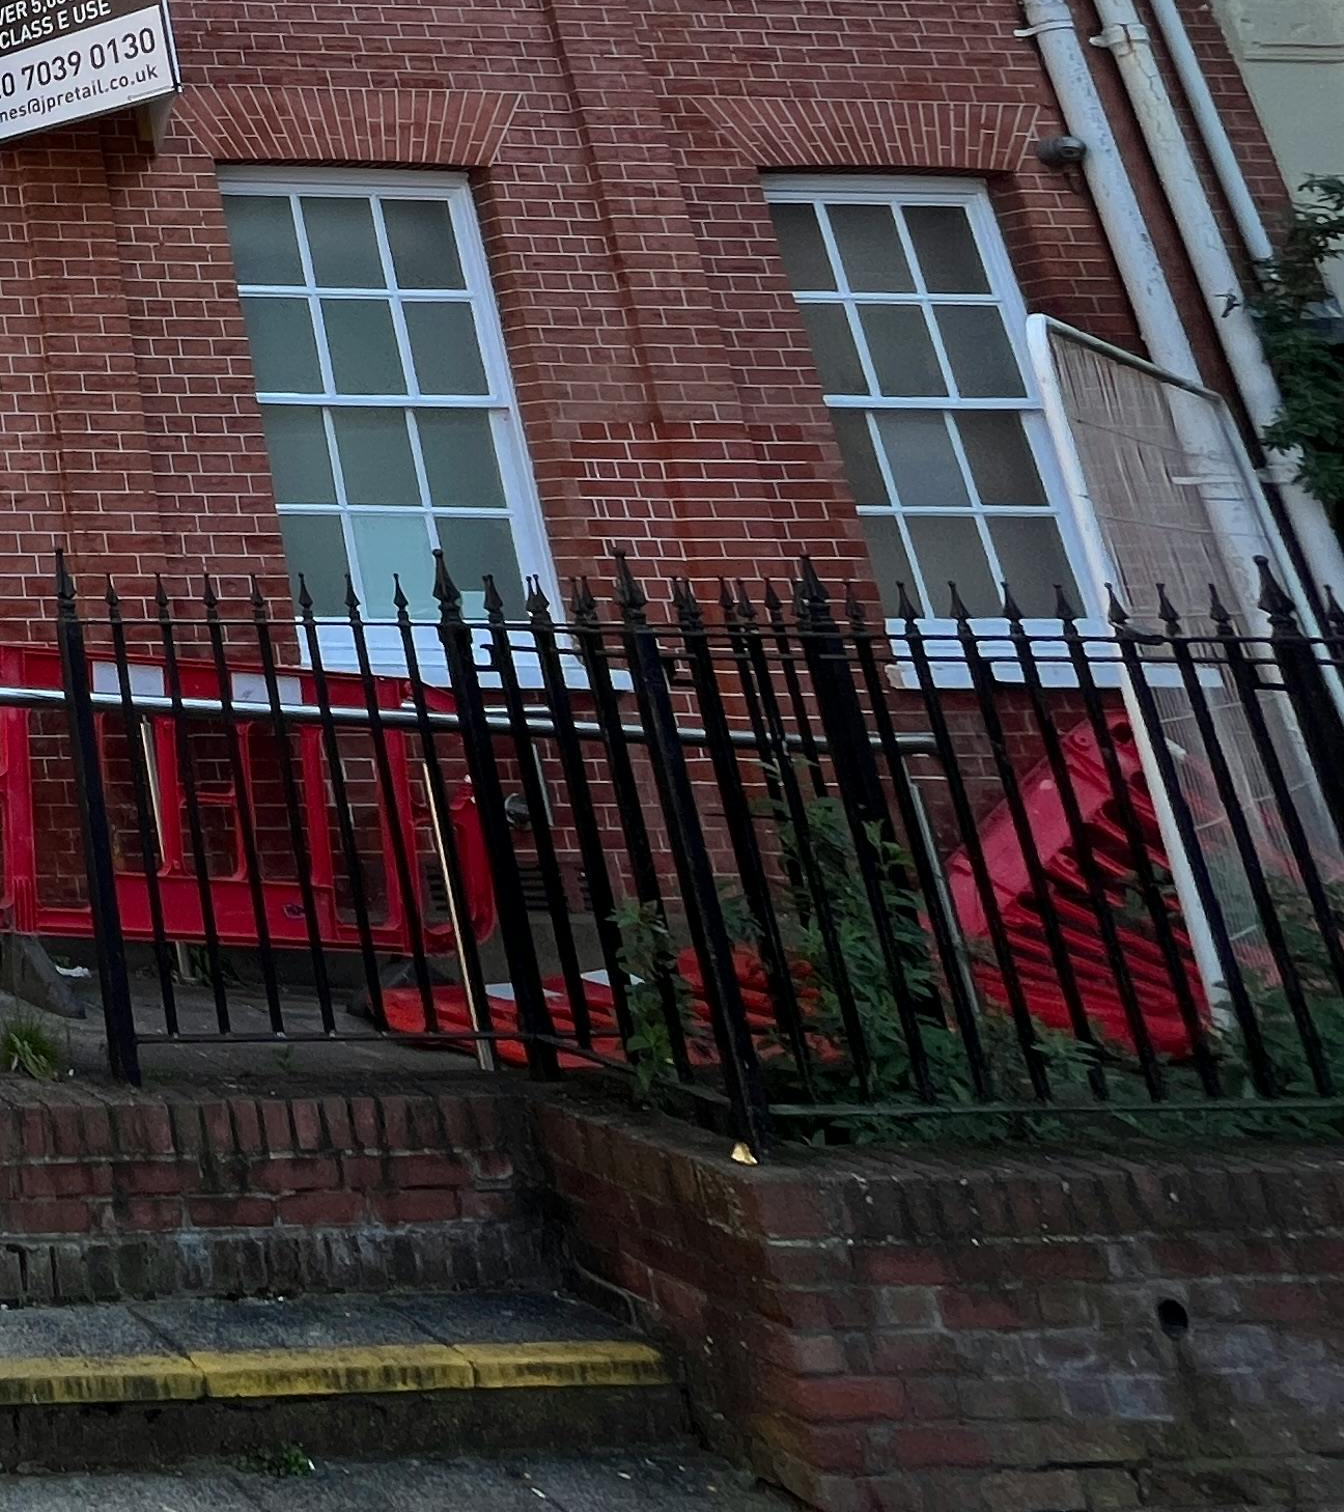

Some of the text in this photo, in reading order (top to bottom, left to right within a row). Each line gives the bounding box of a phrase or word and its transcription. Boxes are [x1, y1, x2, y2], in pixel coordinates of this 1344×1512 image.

[57, 9, 70, 30] E
[21, 51, 82, 92] 7039
[89, 27, 156, 69] 0130
